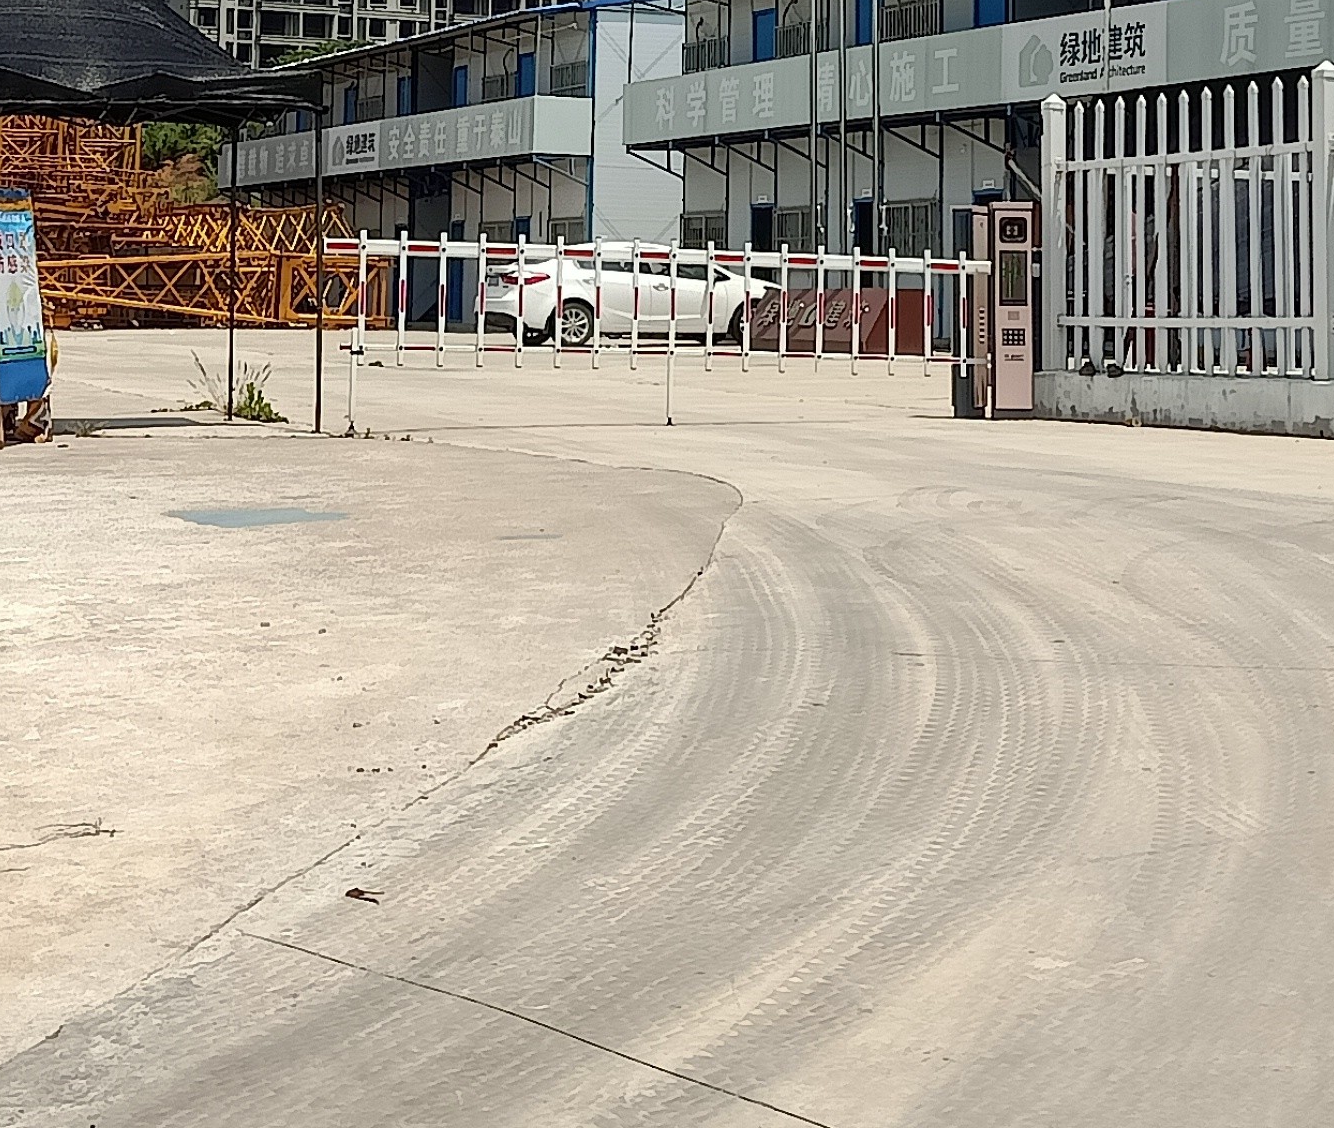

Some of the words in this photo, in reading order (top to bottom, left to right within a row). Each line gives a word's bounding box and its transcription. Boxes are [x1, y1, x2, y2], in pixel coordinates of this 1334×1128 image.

[1059, 21, 1146, 67] 绿地建筑
[654, 71, 776, 132] 科学管理
[816, 47, 960, 113] 精心施工
[1099, 64, 1146, 80] Achitecture
[388, 119, 448, 161] 安全责任
